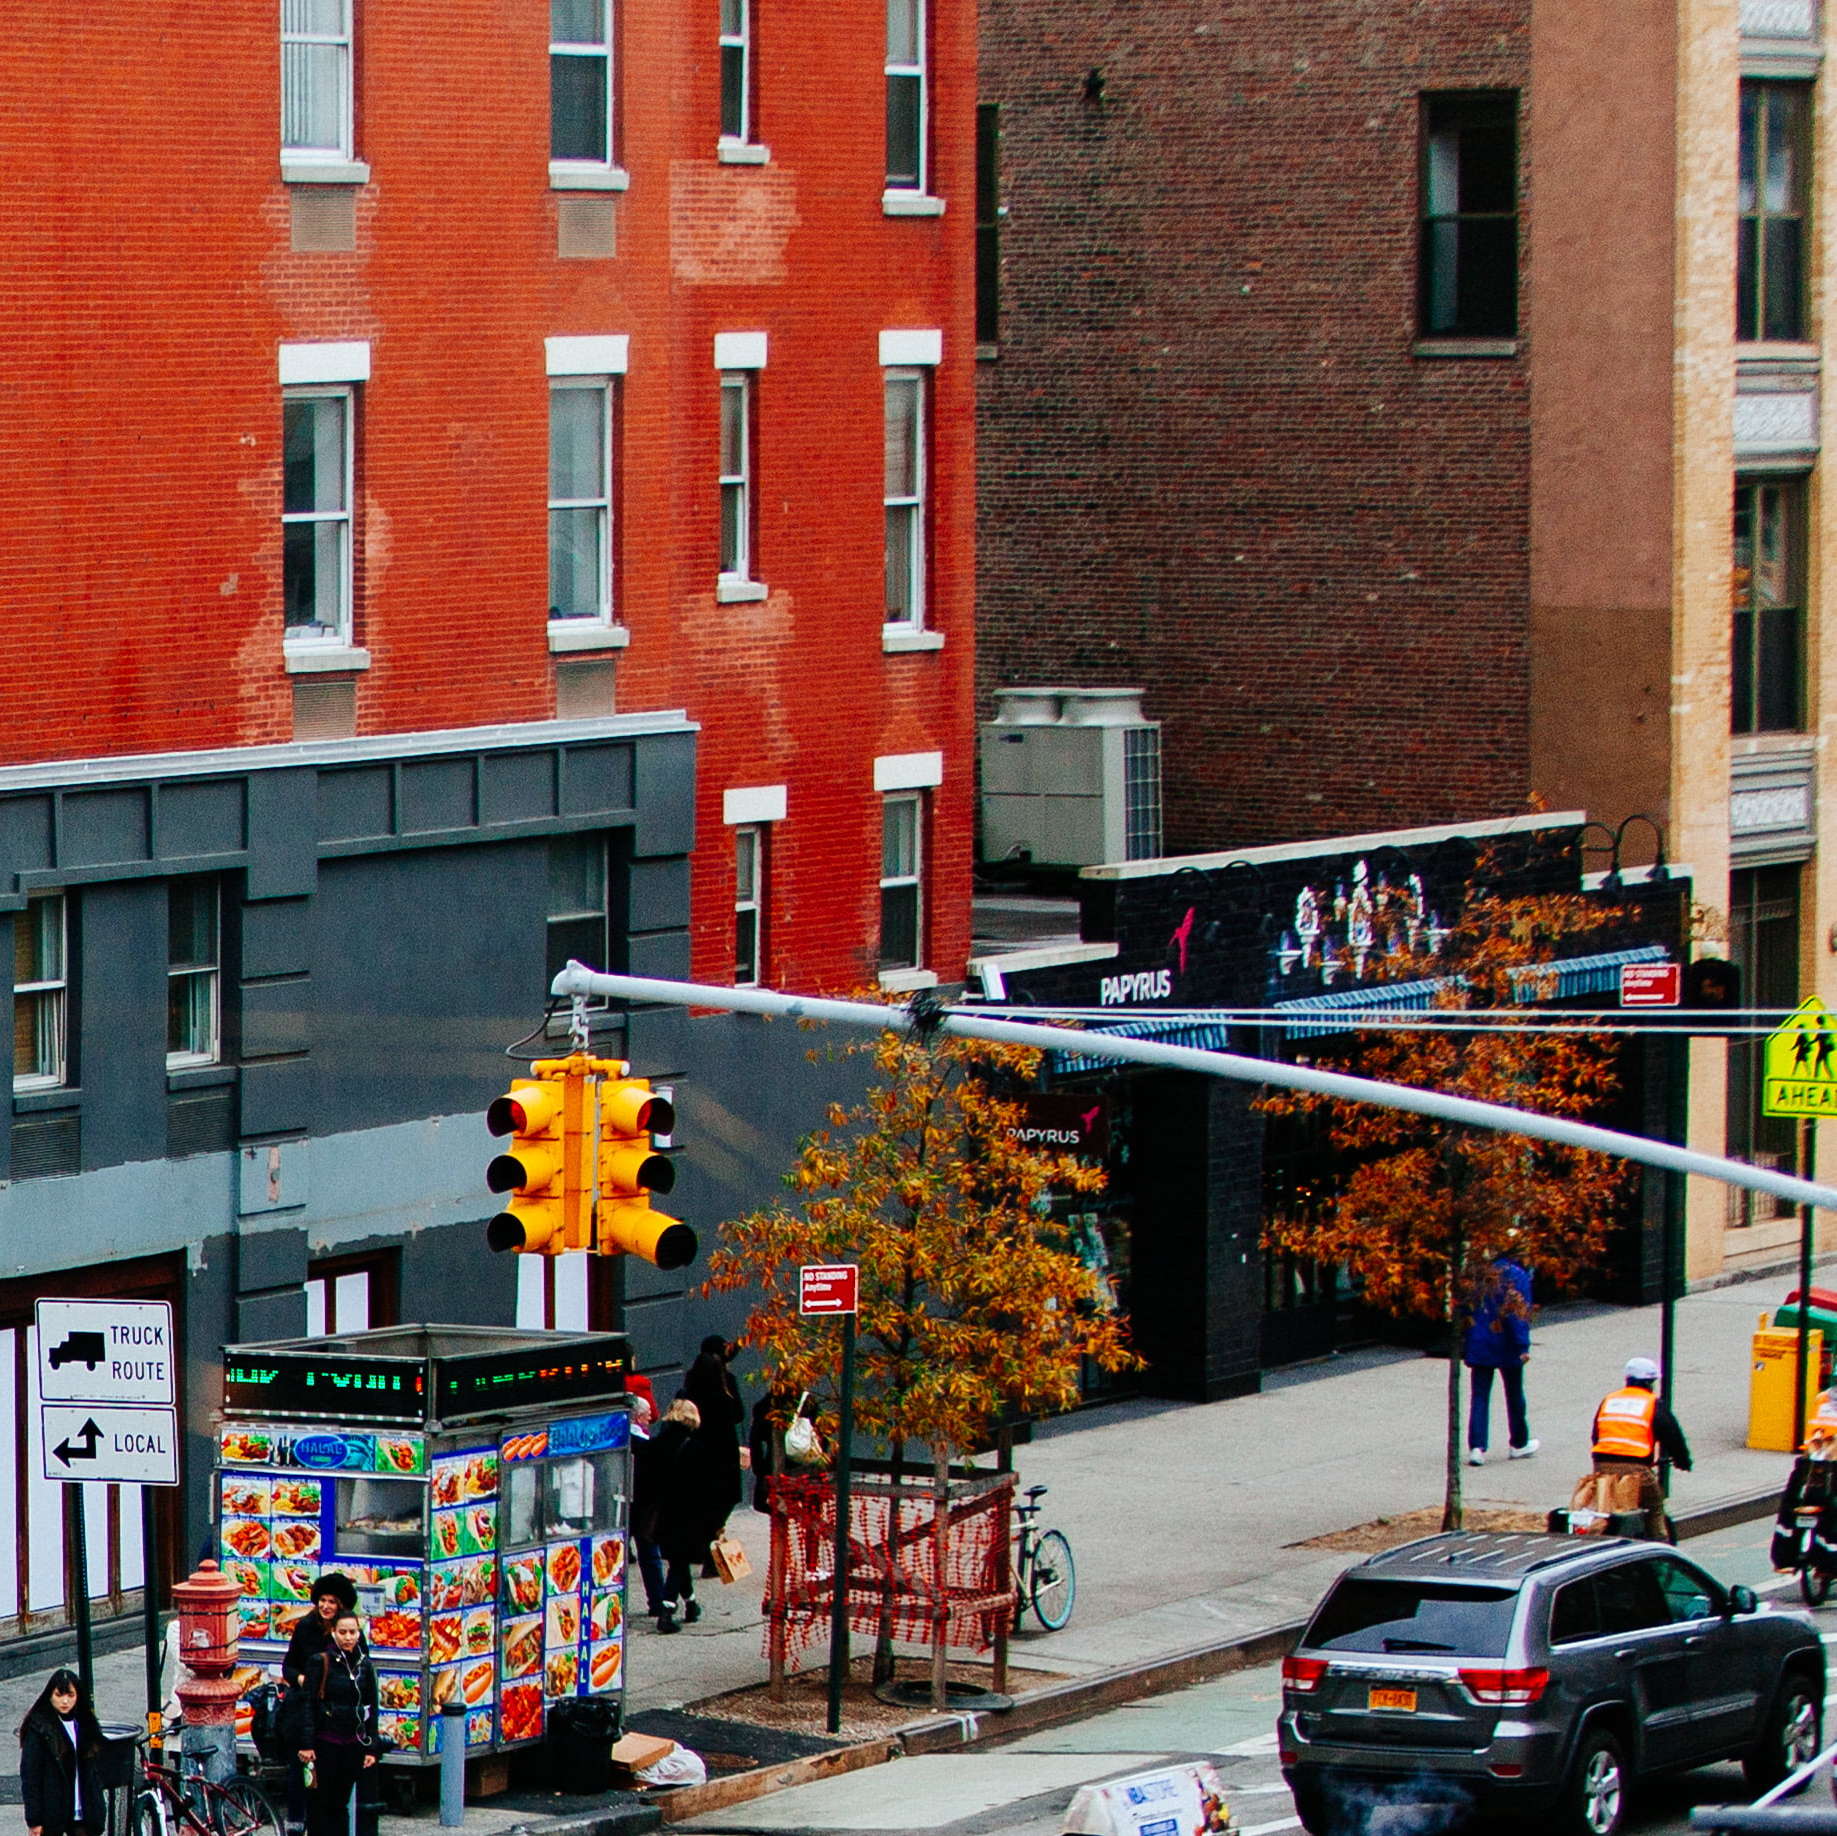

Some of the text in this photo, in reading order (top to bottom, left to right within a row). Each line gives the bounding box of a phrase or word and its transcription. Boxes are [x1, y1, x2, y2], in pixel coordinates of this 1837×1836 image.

[1101, 969, 1172, 1006] PAPYRUS
[1777, 1086, 1837, 1108] AHEA
[804, 1270, 848, 1281] NO STANDING
[110, 1326, 164, 1346] TRUCK
[112, 1361, 165, 1380] ROUTE
[114, 1433, 167, 1454] LOCAL
[300, 1441, 343, 1455] HALAL
[580, 1581, 590, 1684] HALAL
